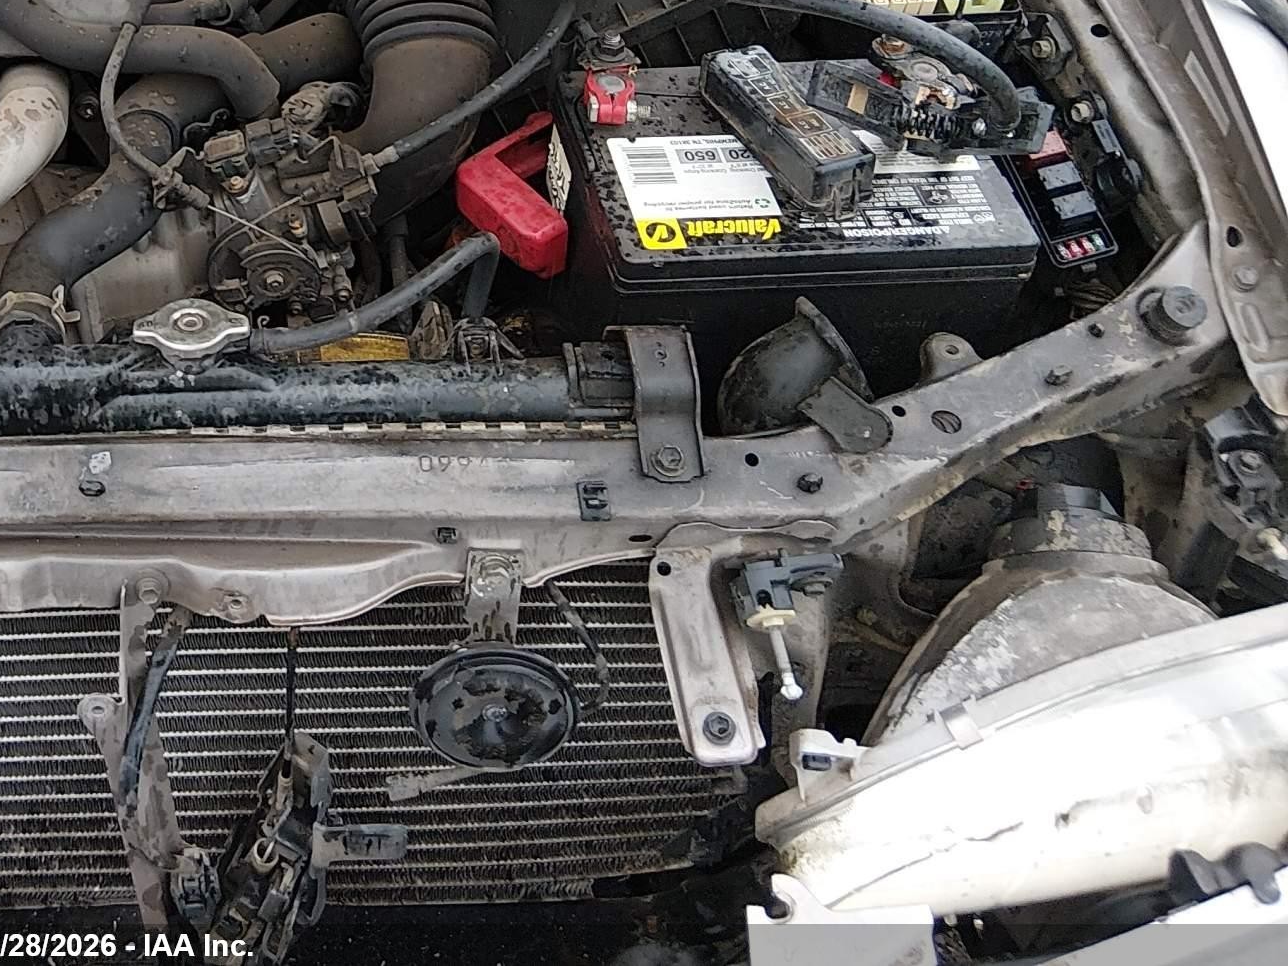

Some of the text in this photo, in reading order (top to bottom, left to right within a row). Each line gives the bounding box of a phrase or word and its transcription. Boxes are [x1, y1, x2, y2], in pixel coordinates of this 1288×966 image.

[685, 150, 716, 161] 650
[729, 149, 754, 159] 20
[687, 218, 783, 241] Valucraft
